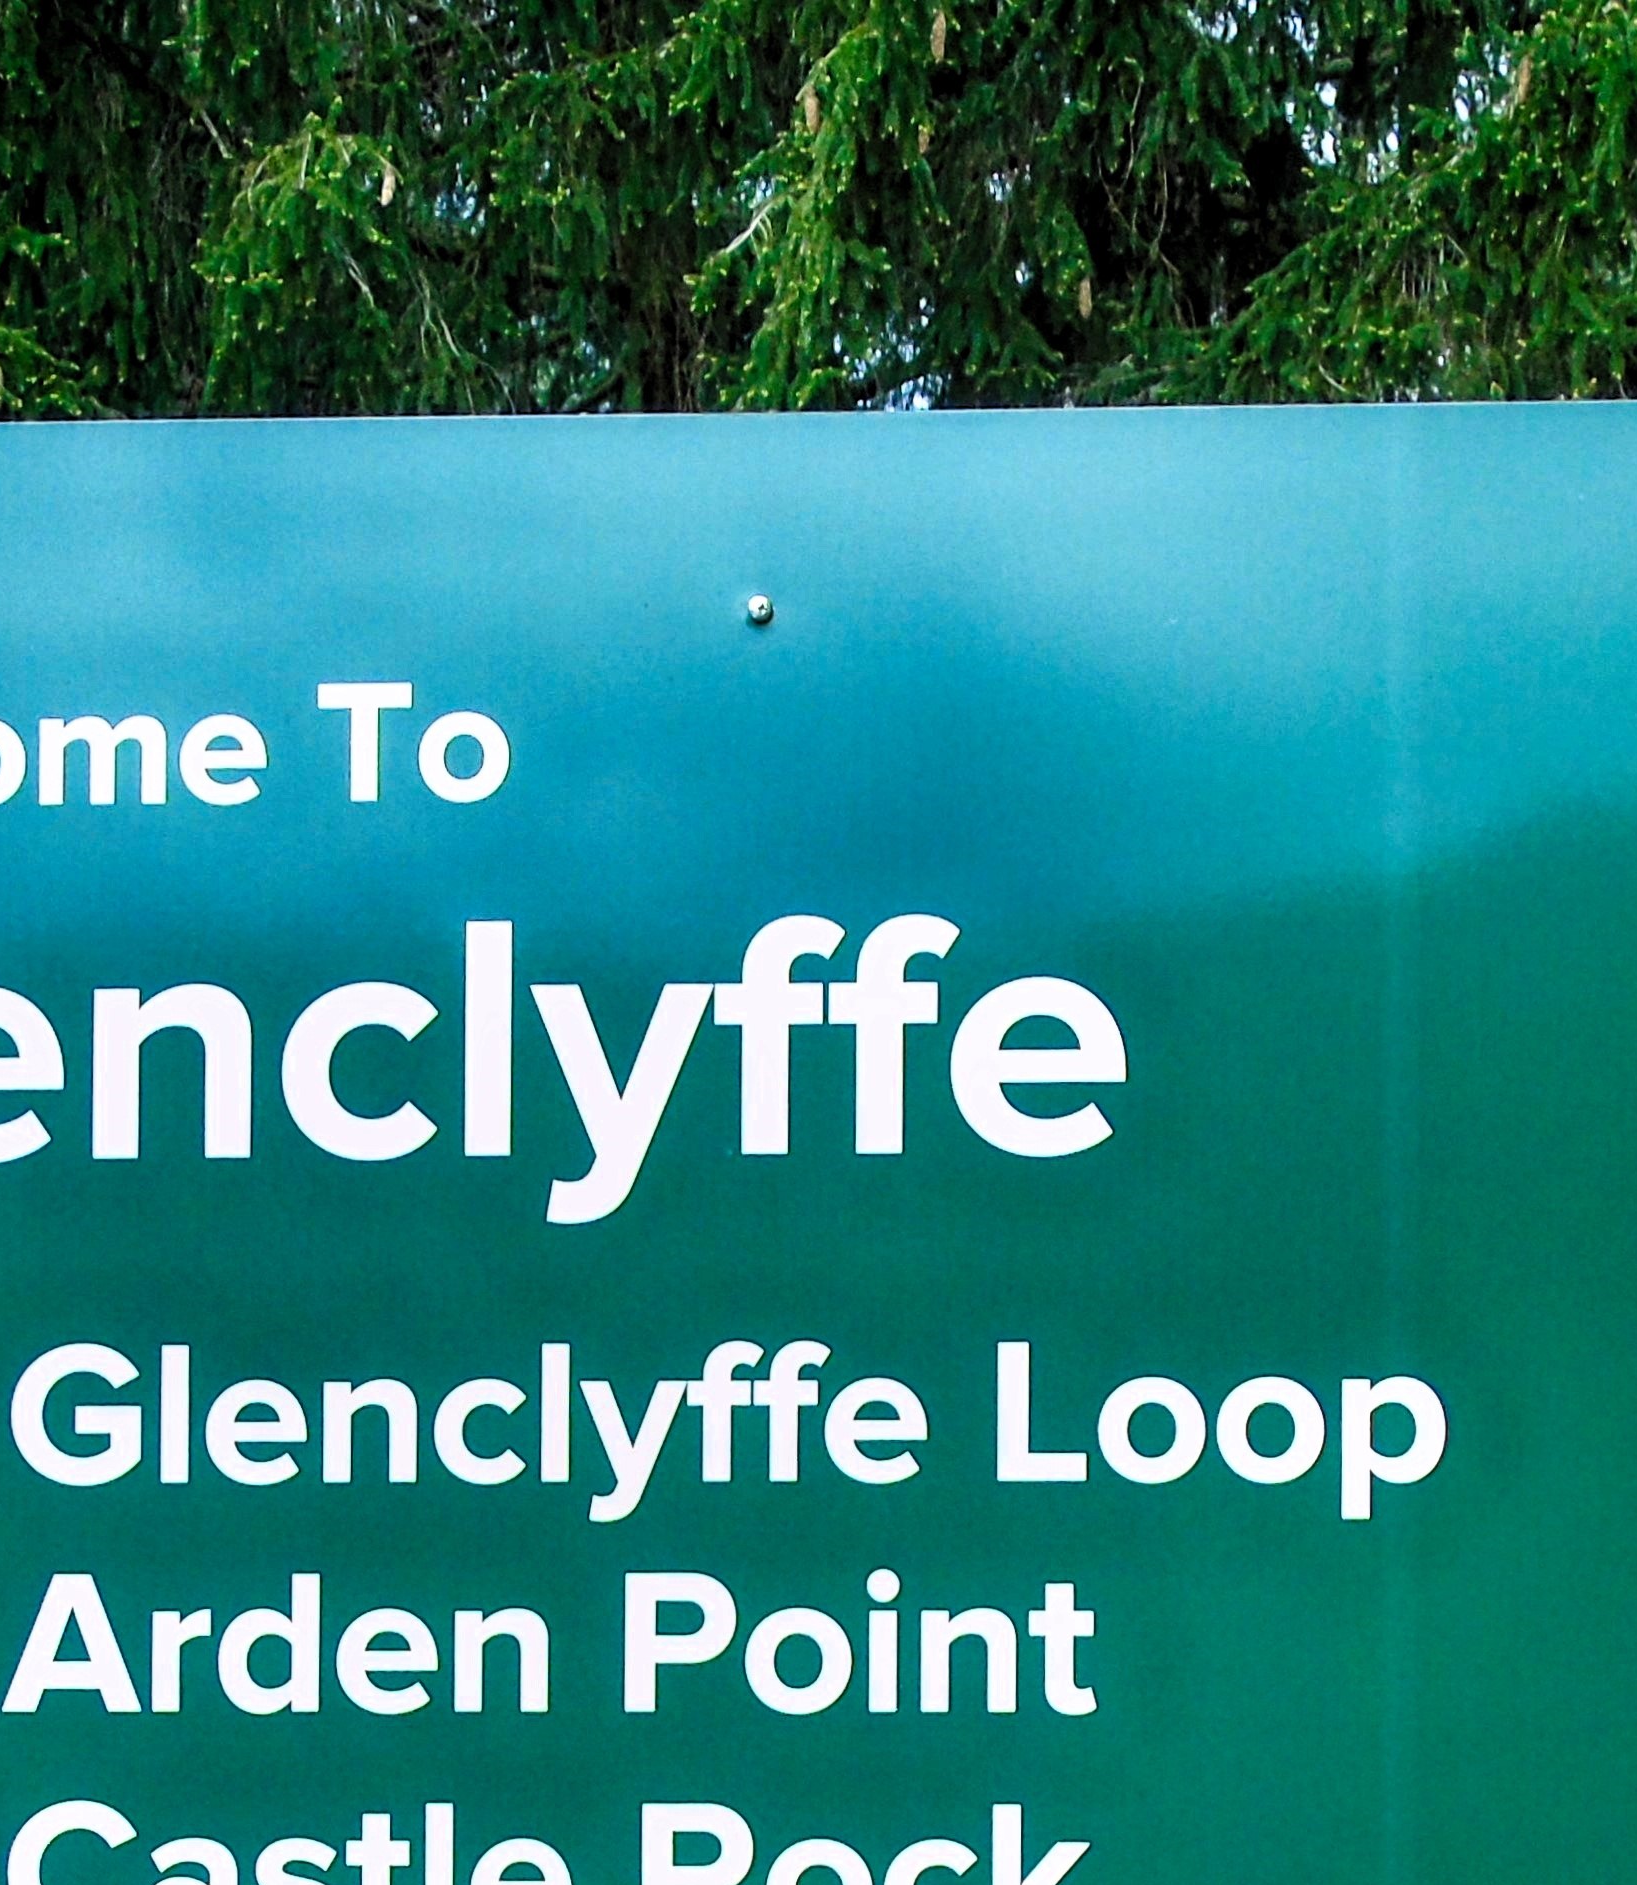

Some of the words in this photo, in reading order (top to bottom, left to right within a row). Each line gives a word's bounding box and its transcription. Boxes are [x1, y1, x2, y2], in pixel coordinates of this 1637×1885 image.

[316, 681, 511, 804] To
[9, 1339, 929, 1523] Glenclyffe
[995, 1340, 1447, 1521] Loop
[0, 1572, 550, 1716] Arden
[623, 1567, 1098, 1717] Point
